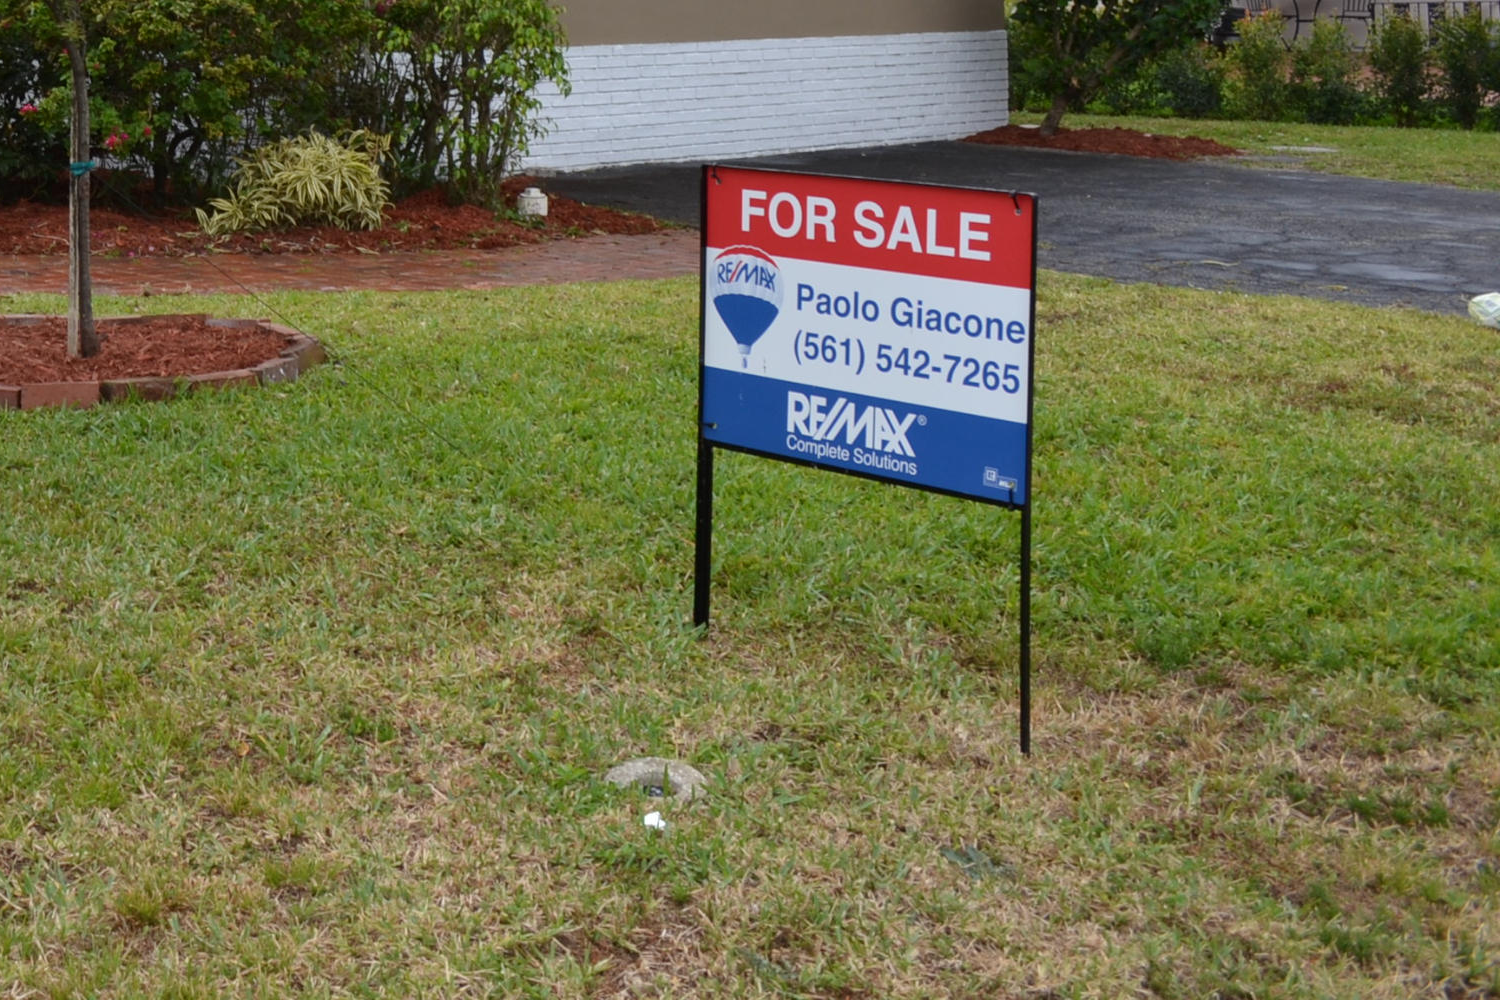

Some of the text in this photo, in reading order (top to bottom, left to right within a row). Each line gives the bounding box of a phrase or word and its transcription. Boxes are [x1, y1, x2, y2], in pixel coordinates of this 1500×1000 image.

[741, 189, 991, 262] FOR SALE
[718, 260, 776, 292] RE/MAX
[797, 283, 1026, 344] Paolo Giacone
[794, 330, 1020, 394] (561) 542-7265
[786, 434, 917, 476] Complete Solutions
[787, 390, 917, 458] RE/MAX
